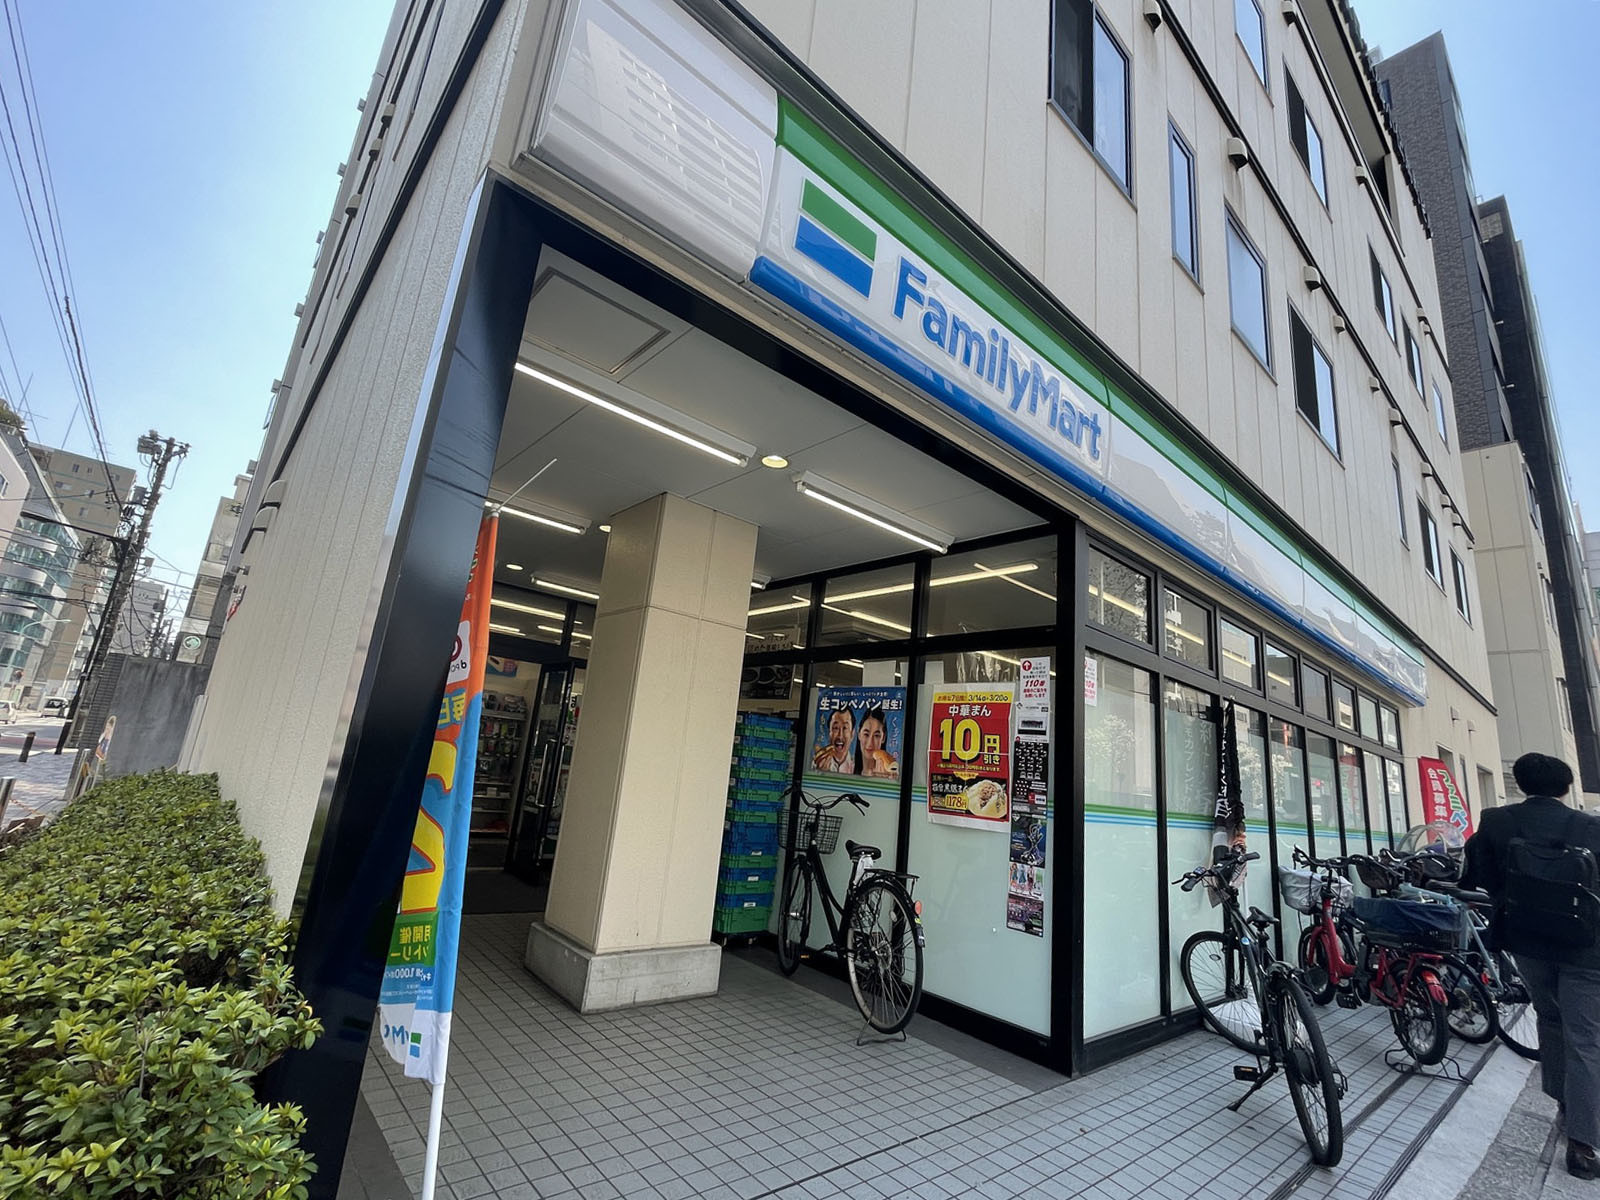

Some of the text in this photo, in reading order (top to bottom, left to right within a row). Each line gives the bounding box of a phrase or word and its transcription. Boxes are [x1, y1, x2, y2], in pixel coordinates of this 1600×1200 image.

[893, 256, 1102, 460] FamilyMart
[948, 704, 992, 718] 中華まん
